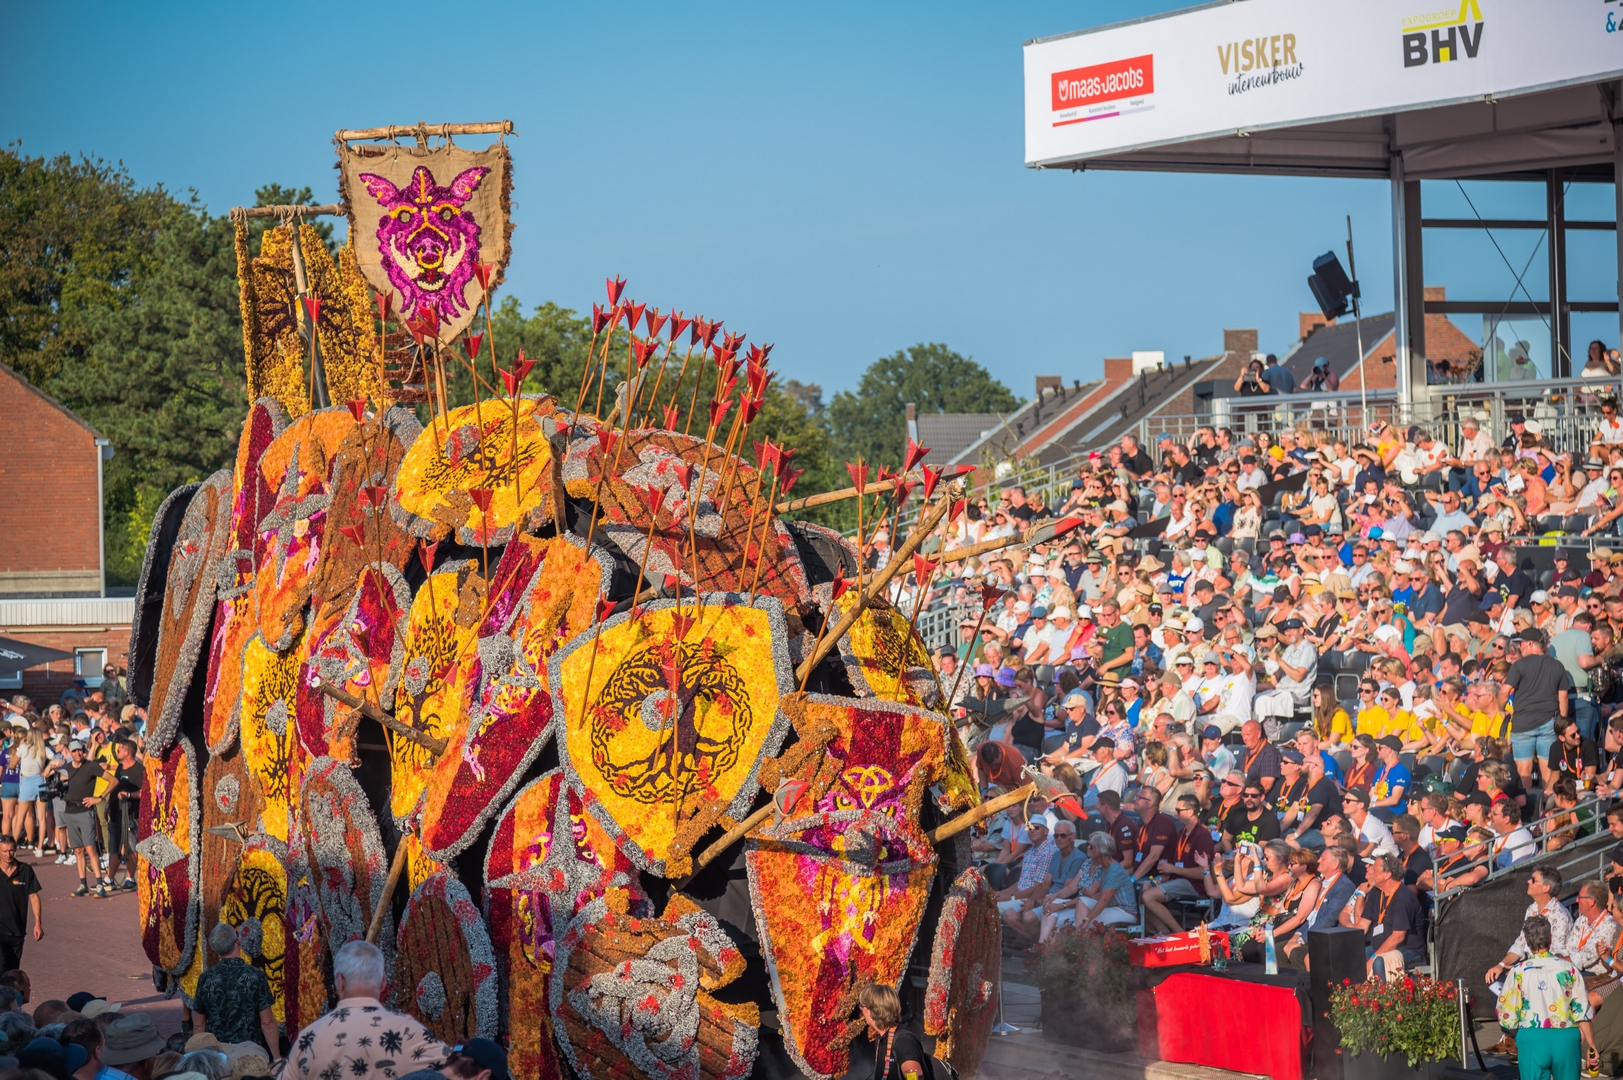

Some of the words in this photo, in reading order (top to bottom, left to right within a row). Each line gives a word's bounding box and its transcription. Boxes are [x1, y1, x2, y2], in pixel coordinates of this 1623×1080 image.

[1401, 9, 1457, 27] EXPOGROEP
[1217, 33, 1297, 75] VISKER
[1402, 21, 1484, 68] BHV
